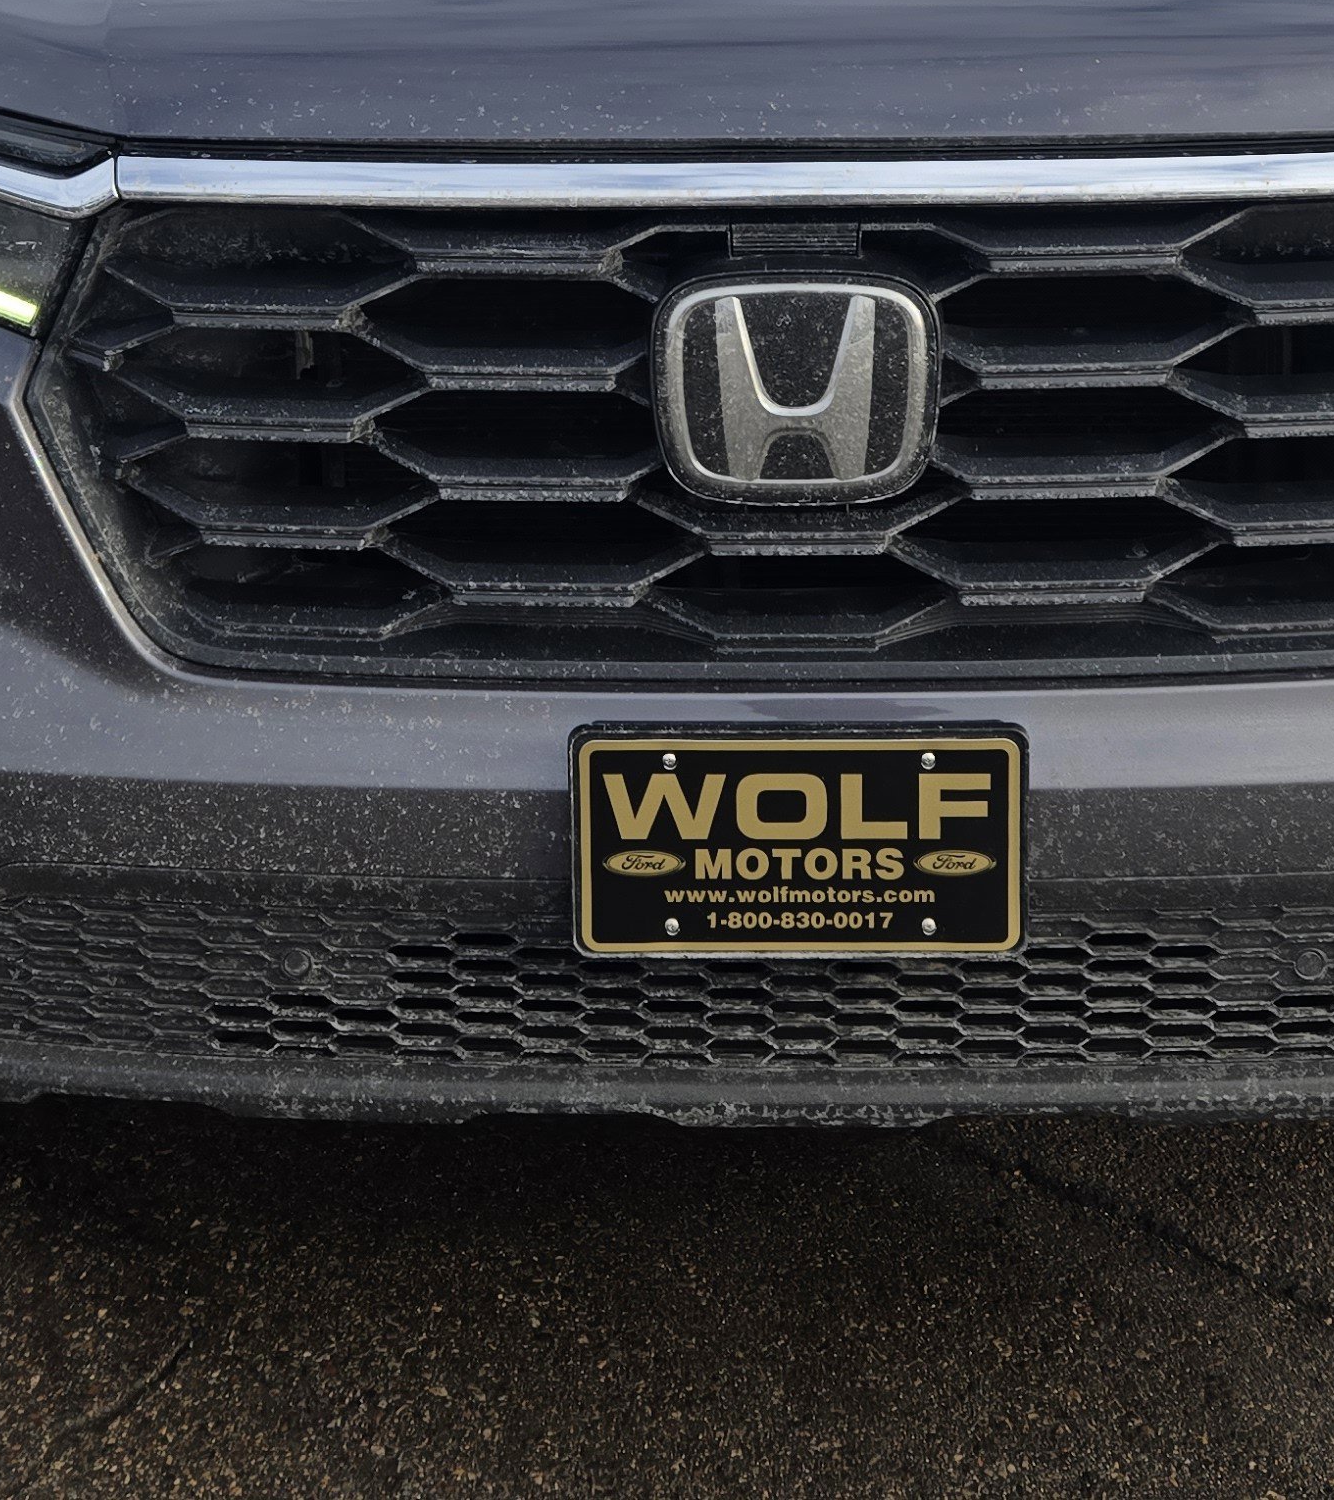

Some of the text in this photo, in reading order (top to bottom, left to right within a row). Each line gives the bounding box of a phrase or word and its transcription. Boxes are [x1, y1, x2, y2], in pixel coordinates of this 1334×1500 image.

[602, 773, 992, 840] WOLF
[620, 854, 666, 872] Ford
[694, 847, 906, 880] MOTORS
[931, 854, 977, 872] Ford
[664, 885, 936, 904] www.wolfmotors.com
[707, 911, 894, 930] 1-800-830-0017
